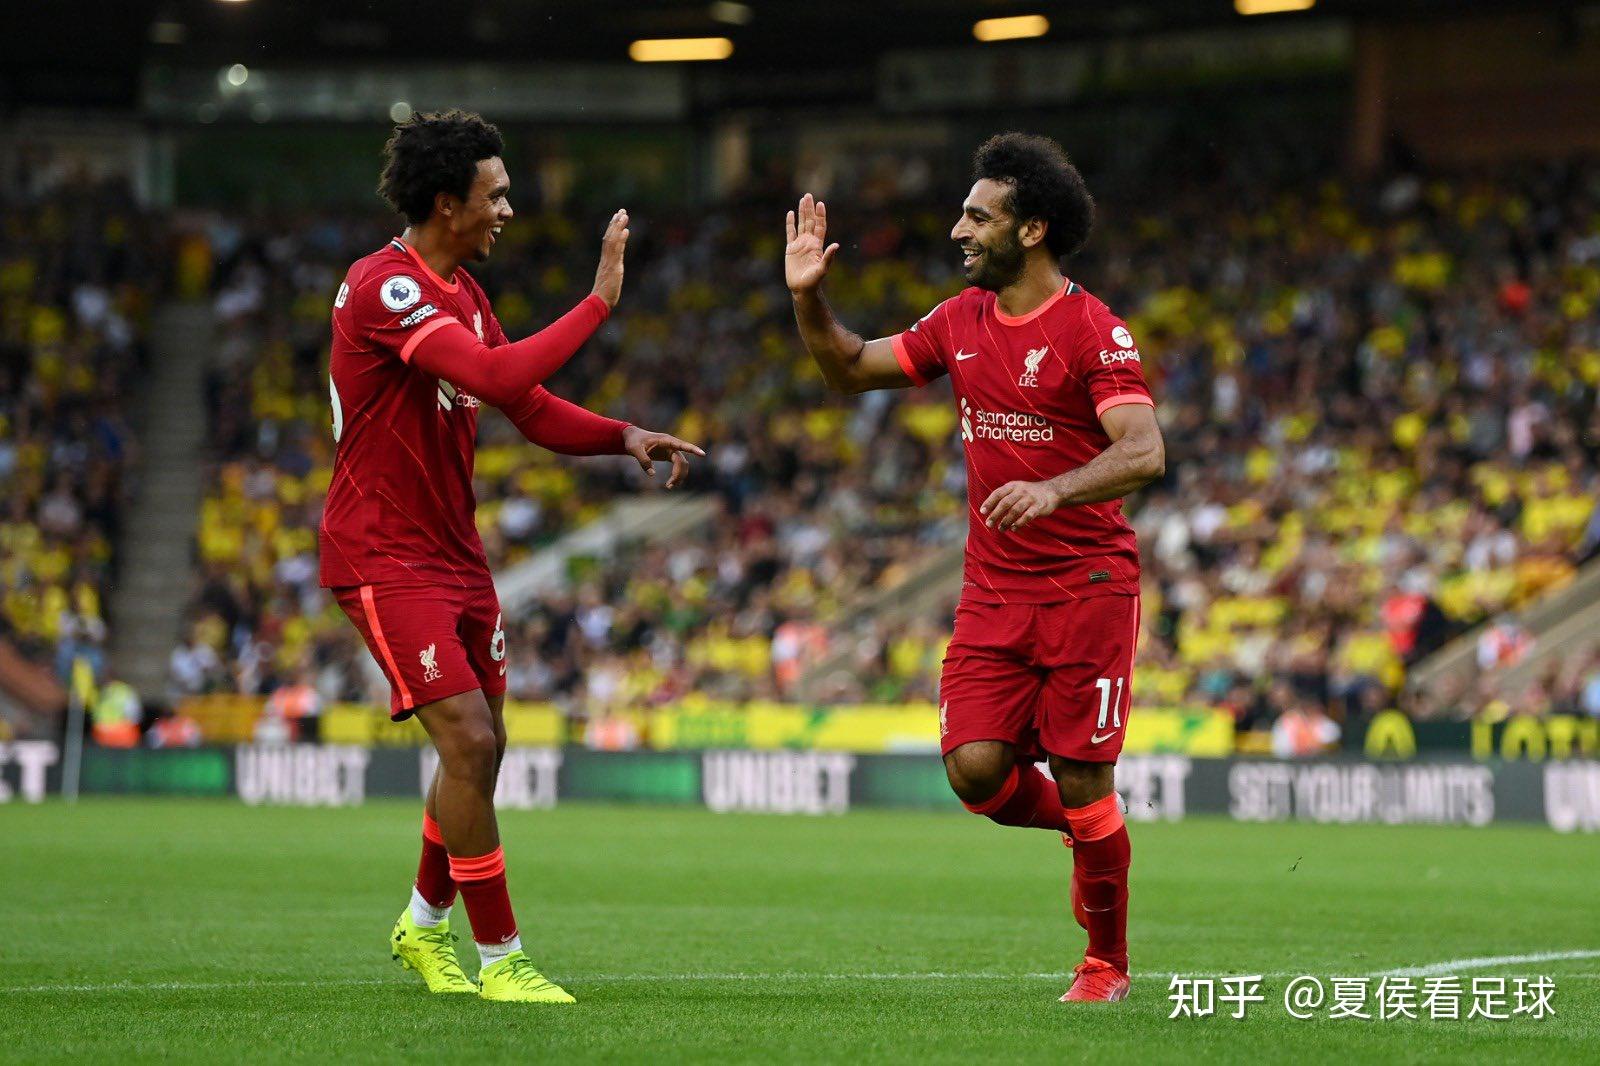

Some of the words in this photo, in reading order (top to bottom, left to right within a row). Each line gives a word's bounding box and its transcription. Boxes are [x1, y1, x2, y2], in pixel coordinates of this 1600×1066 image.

[976, 410, 1047, 427] standard
[976, 424, 1053, 442] chartered
[1096, 677, 1124, 729] 11
[235, 743, 371, 807] UNIBET
[703, 751, 857, 815] UNIBET
